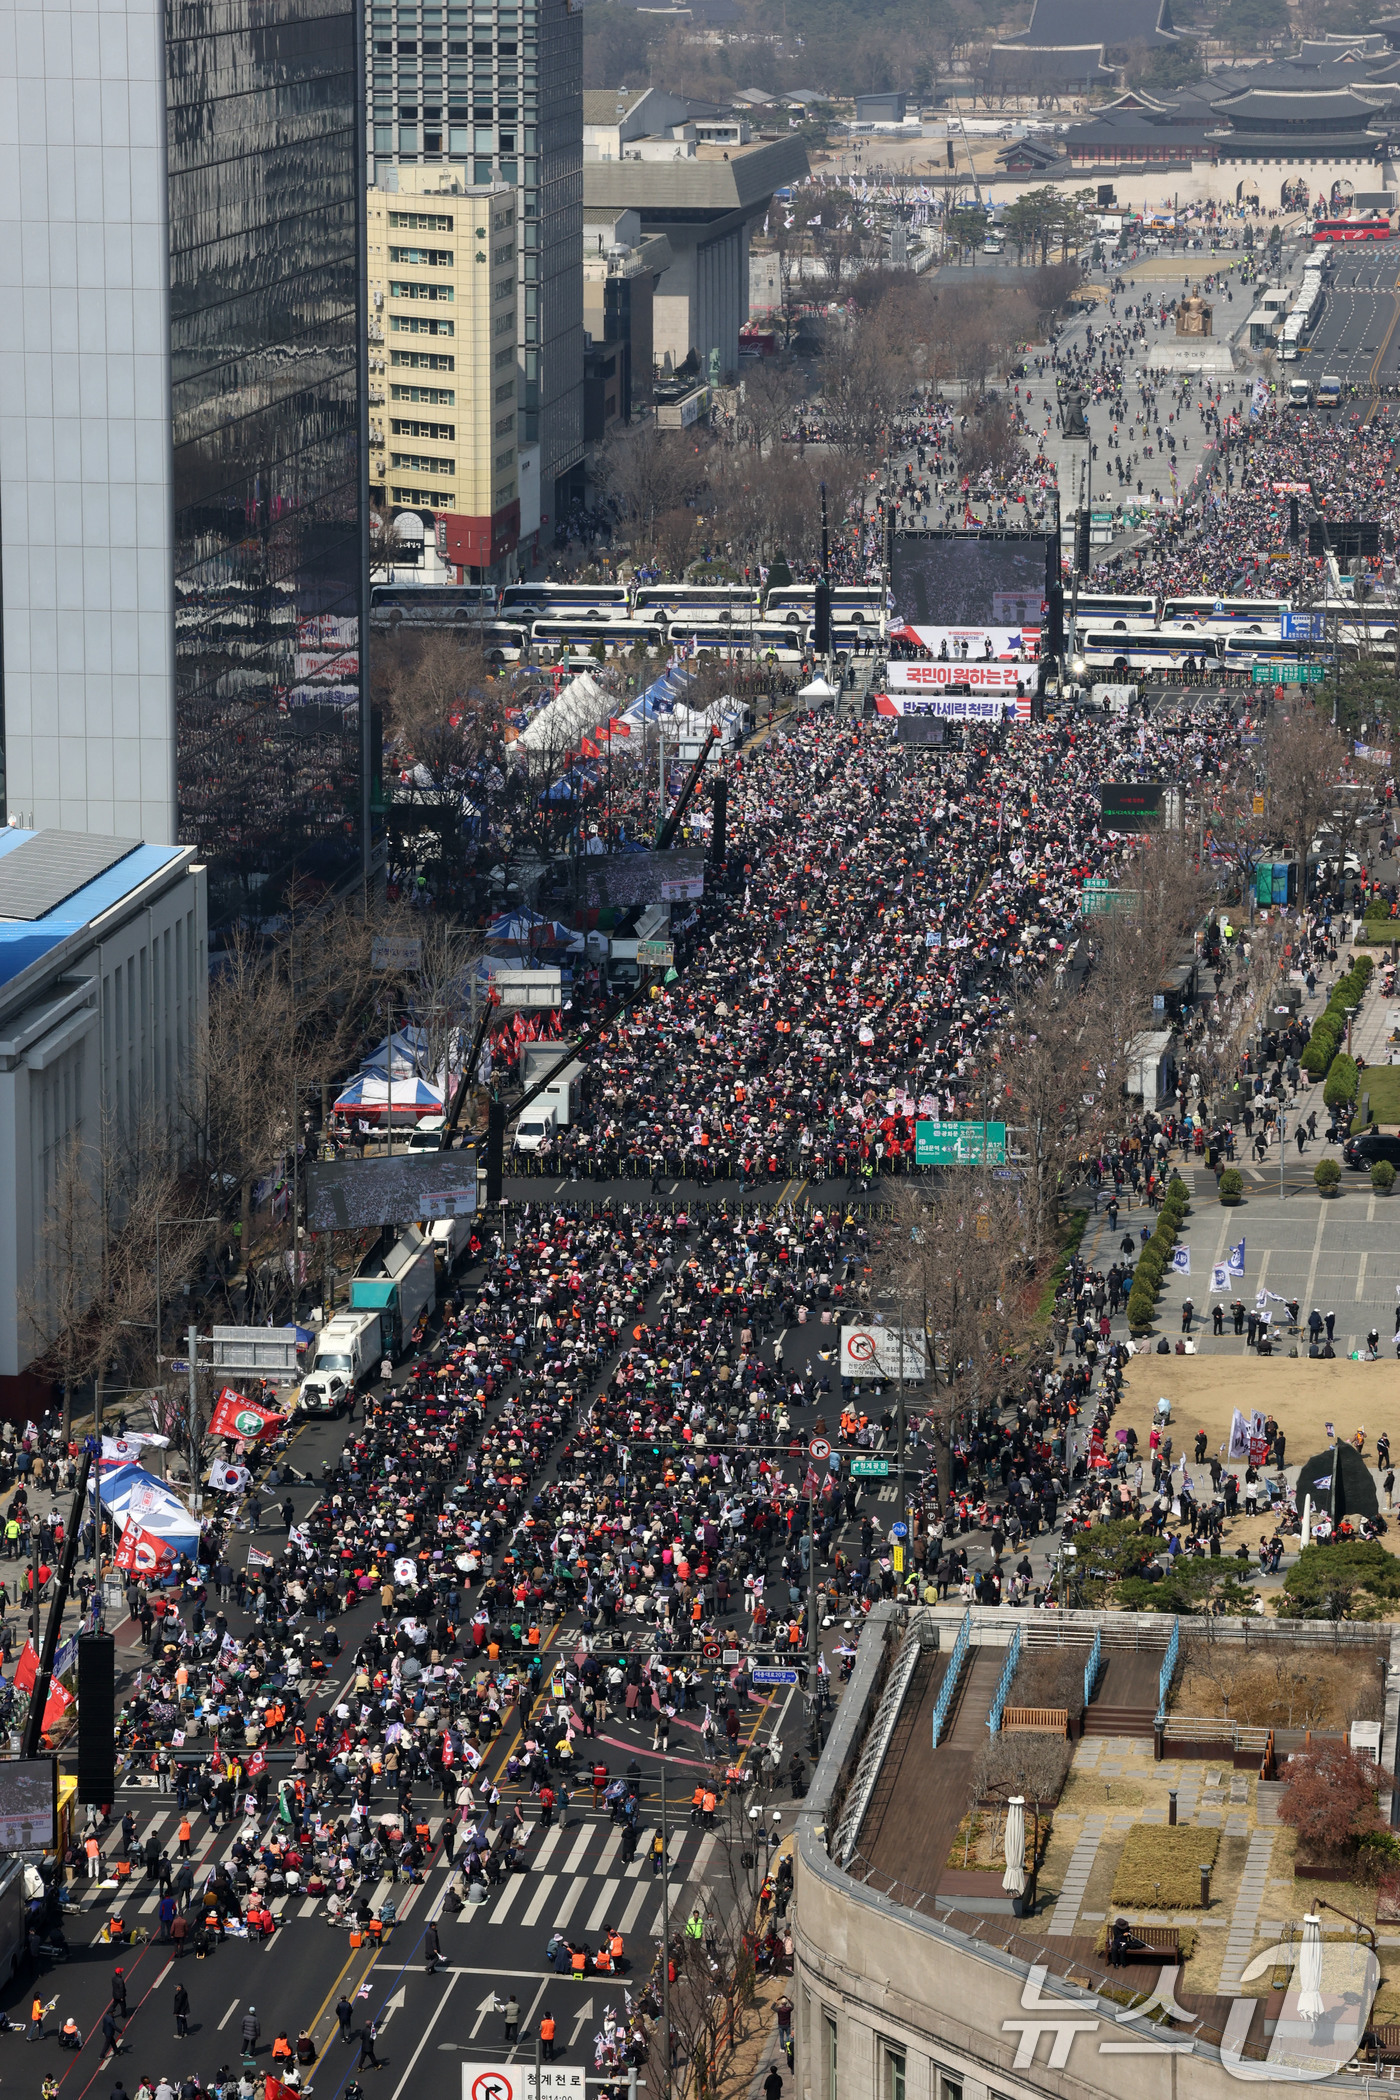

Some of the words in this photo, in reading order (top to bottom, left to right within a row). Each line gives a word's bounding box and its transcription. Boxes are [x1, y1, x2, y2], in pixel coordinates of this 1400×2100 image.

[906, 667, 952, 684] 국민이
[953, 667, 1002, 685] 원하는
[1003, 669, 1019, 685] 건
[968, 702, 999, 717] 척결!
[527, 2073, 582, 2086] 청계천로
